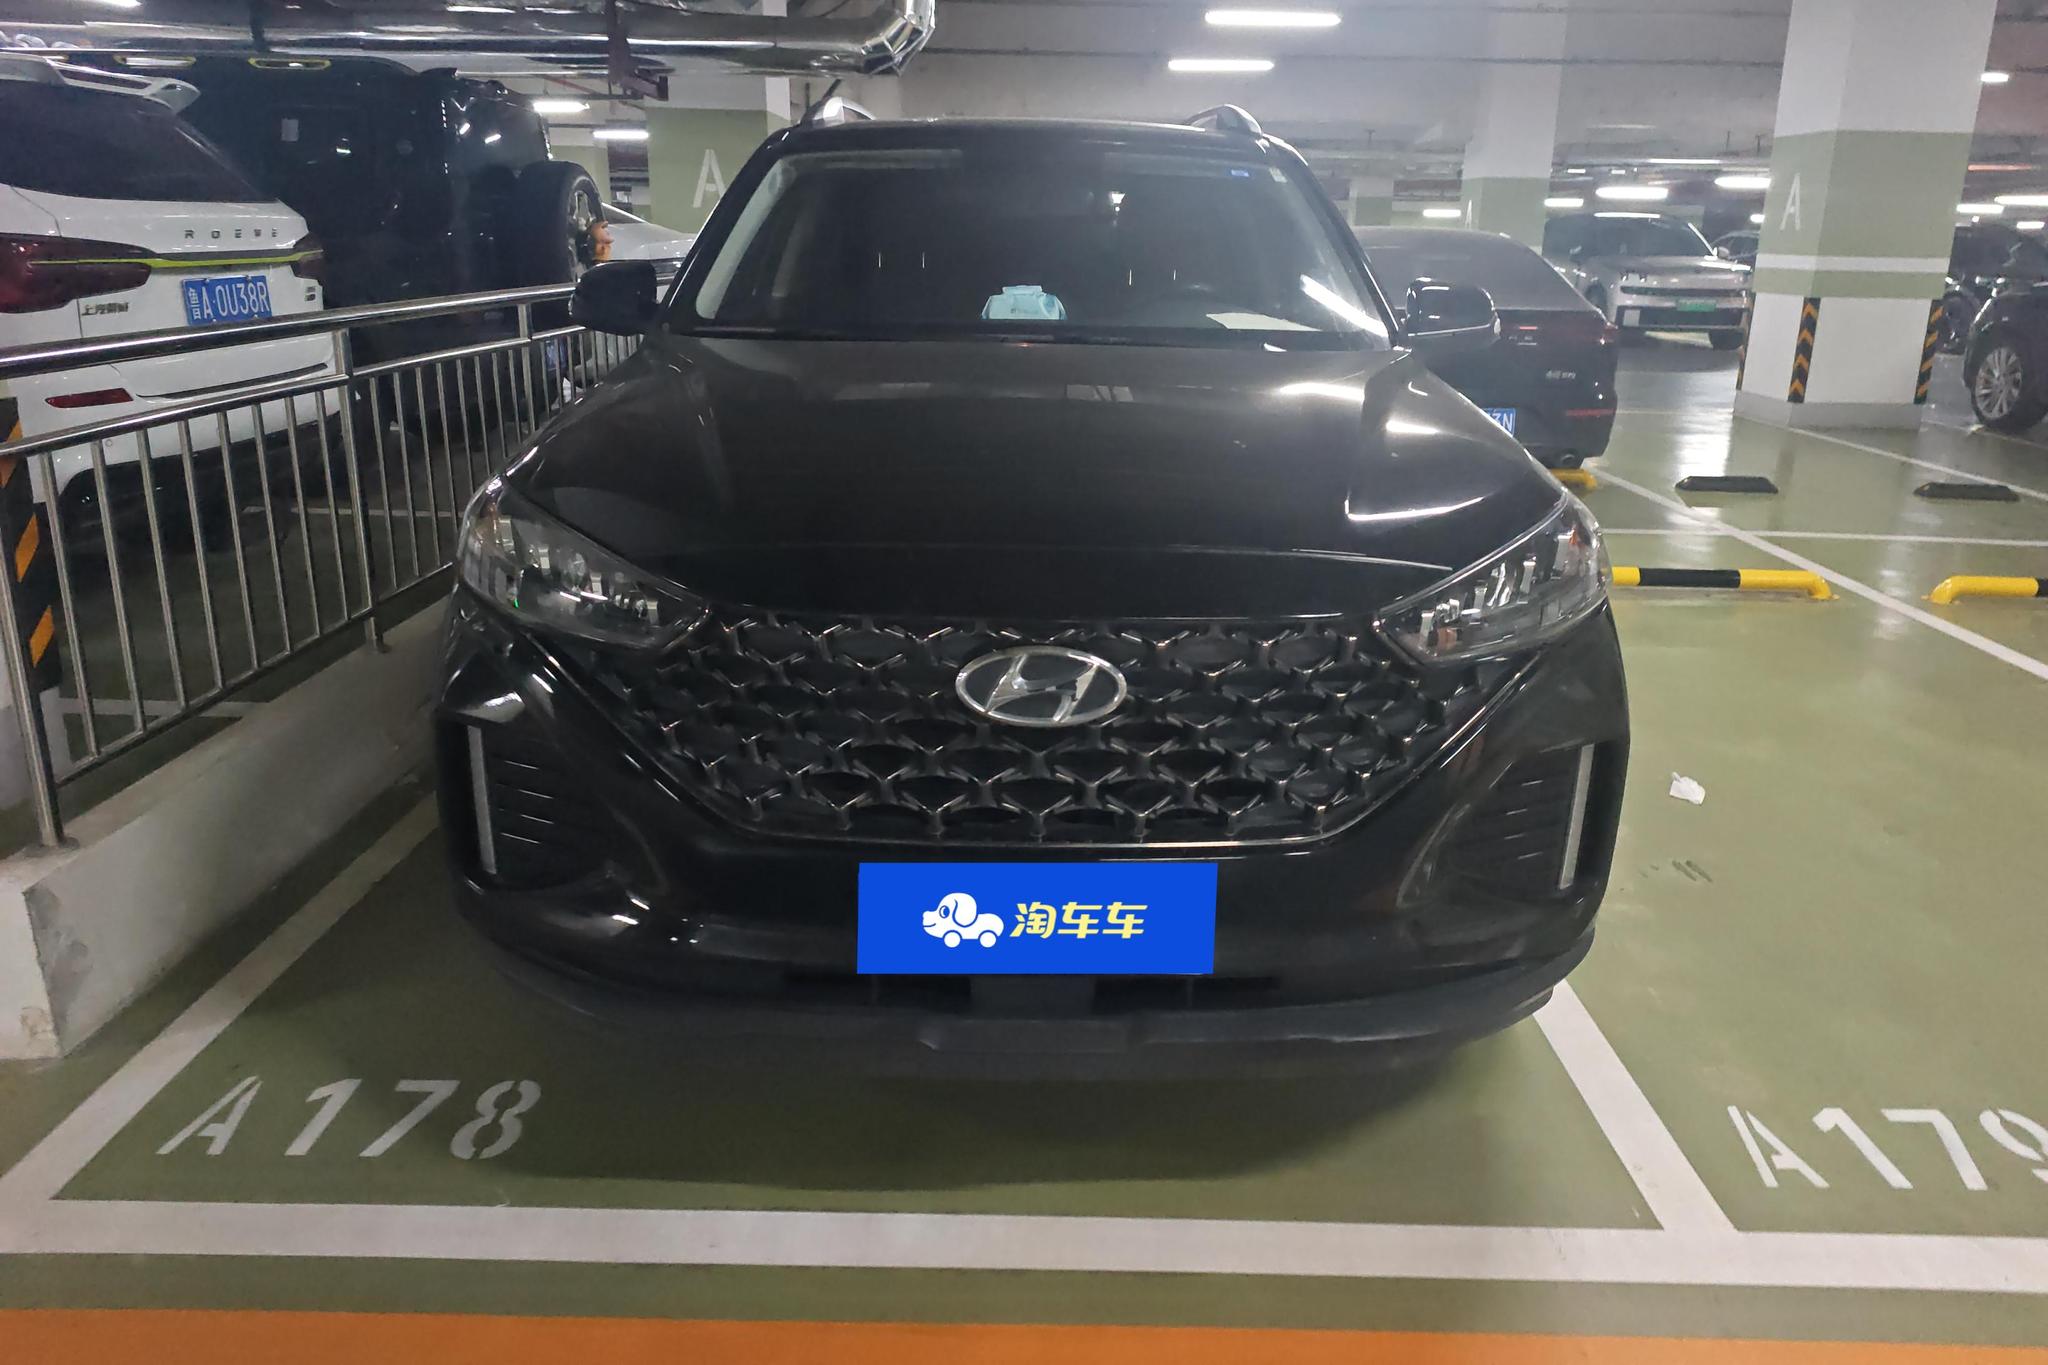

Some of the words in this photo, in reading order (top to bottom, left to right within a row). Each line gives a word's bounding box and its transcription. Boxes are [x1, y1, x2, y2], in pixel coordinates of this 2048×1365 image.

[693, 148, 726, 208] A
[1779, 172, 1800, 231] A
[156, 1075, 541, 1160] A178
[1727, 1105, 2048, 1191] A179
